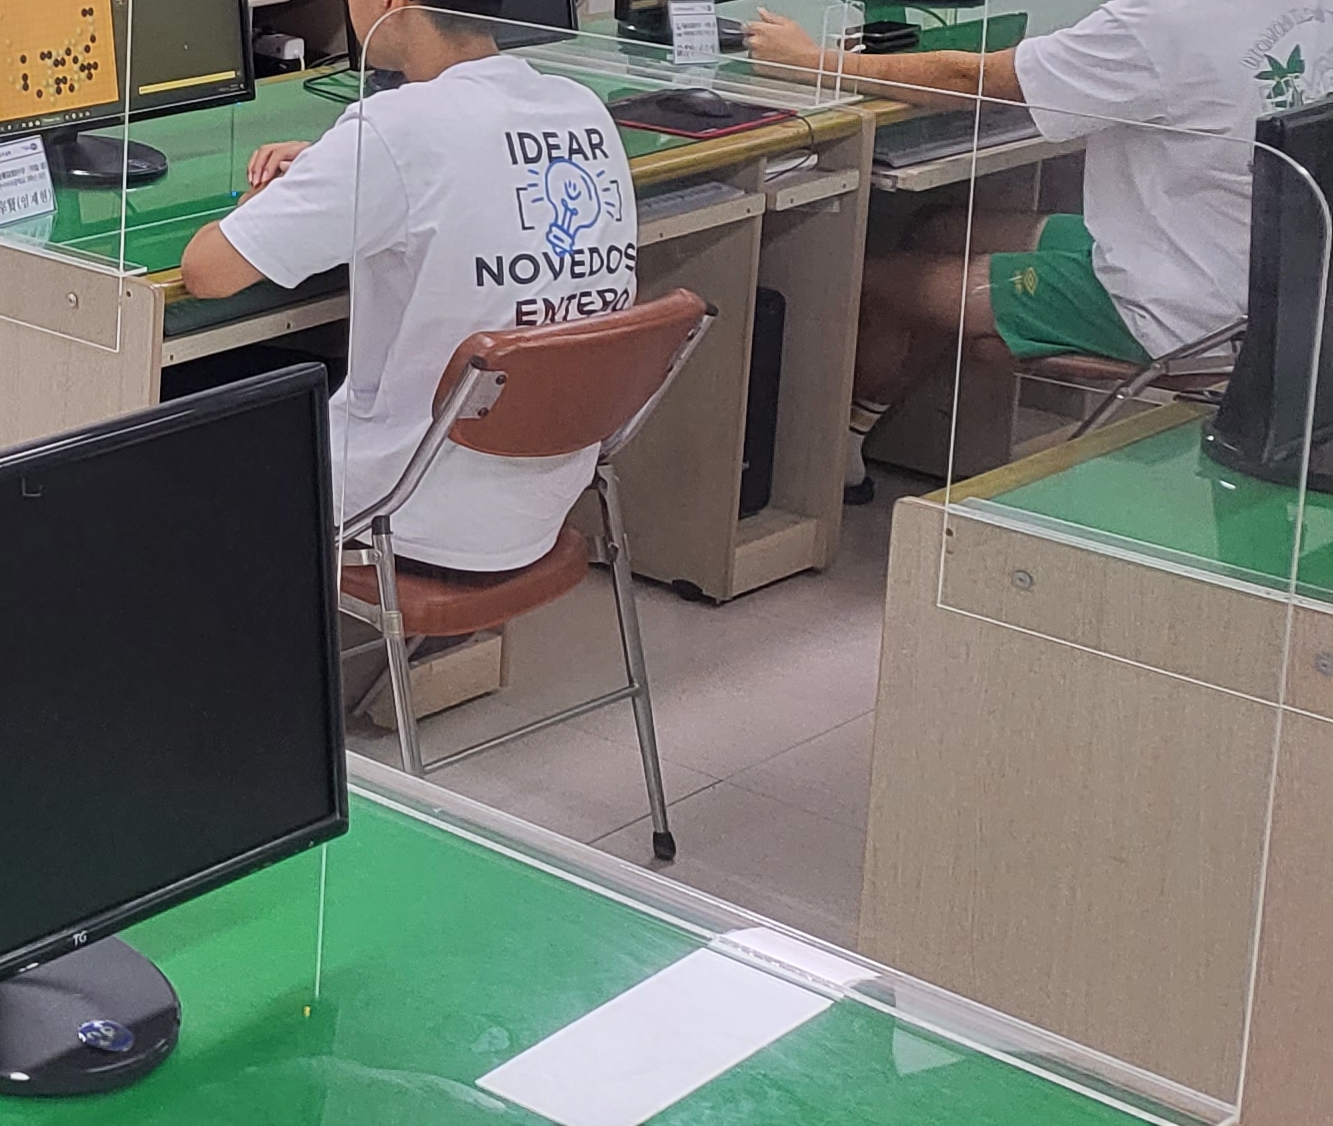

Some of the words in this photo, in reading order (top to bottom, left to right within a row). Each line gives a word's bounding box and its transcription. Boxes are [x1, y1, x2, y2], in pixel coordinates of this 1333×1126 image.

[504, 128, 610, 166] IDEAR
[475, 242, 637, 287] NOVEDOS
[72, 930, 88, 946] TG
